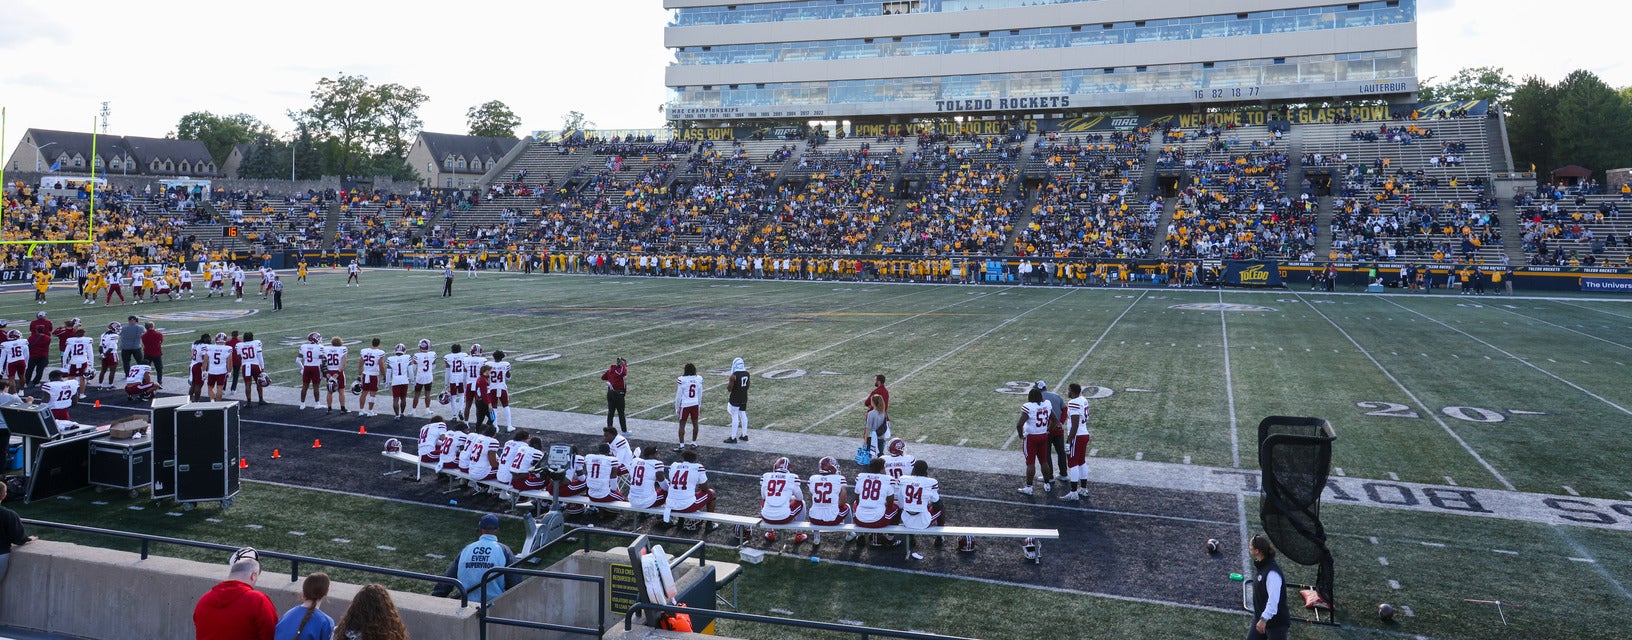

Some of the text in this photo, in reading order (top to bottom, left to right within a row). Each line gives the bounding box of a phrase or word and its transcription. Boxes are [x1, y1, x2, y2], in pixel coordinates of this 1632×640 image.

[1194, 86, 1260, 99] 16 82 18 77
[1359, 82, 1406, 94] LAUTERBUR
[936, 95, 1070, 112] TOLEDO ROCKETS
[1111, 117, 1139, 126] MAC
[1179, 111, 1242, 128] WELCOME
[1246, 111, 1264, 125] TO
[1299, 106, 1345, 124] GLASS
[1350, 105, 1392, 122] BOWL
[672, 128, 703, 140] GLASS
[707, 127, 735, 140] BOWL
[855, 123, 885, 137] HOME
[888, 123, 902, 136] OF
[228, 227, 237, 237] 16
[1239, 270, 1270, 282] TOLEDO
[11, 346, 22, 358] 16
[73, 344, 84, 356] 12
[242, 347, 255, 360] 50
[213, 352, 221, 365] 5
[306, 351, 313, 363] 9
[327, 353, 339, 366] 26
[363, 355, 375, 367] 25
[397, 363, 402, 376] 1
[422, 360, 430, 372] 3
[452, 360, 462, 373] 12
[469, 365, 478, 378] 11
[490, 370, 504, 383] 24
[740, 376, 749, 387] 17
[57, 390, 72, 401] 13
[688, 383, 696, 398] 6
[1035, 409, 1050, 428] 53
[469, 443, 484, 463] 23
[511, 452, 525, 470] 21
[630, 465, 645, 487] 19
[671, 469, 689, 490] 44
[767, 479, 787, 497] 97
[814, 482, 833, 504] 52
[861, 478, 882, 501] 88
[905, 484, 923, 505] 94
[472, 546, 492, 555] CSC
